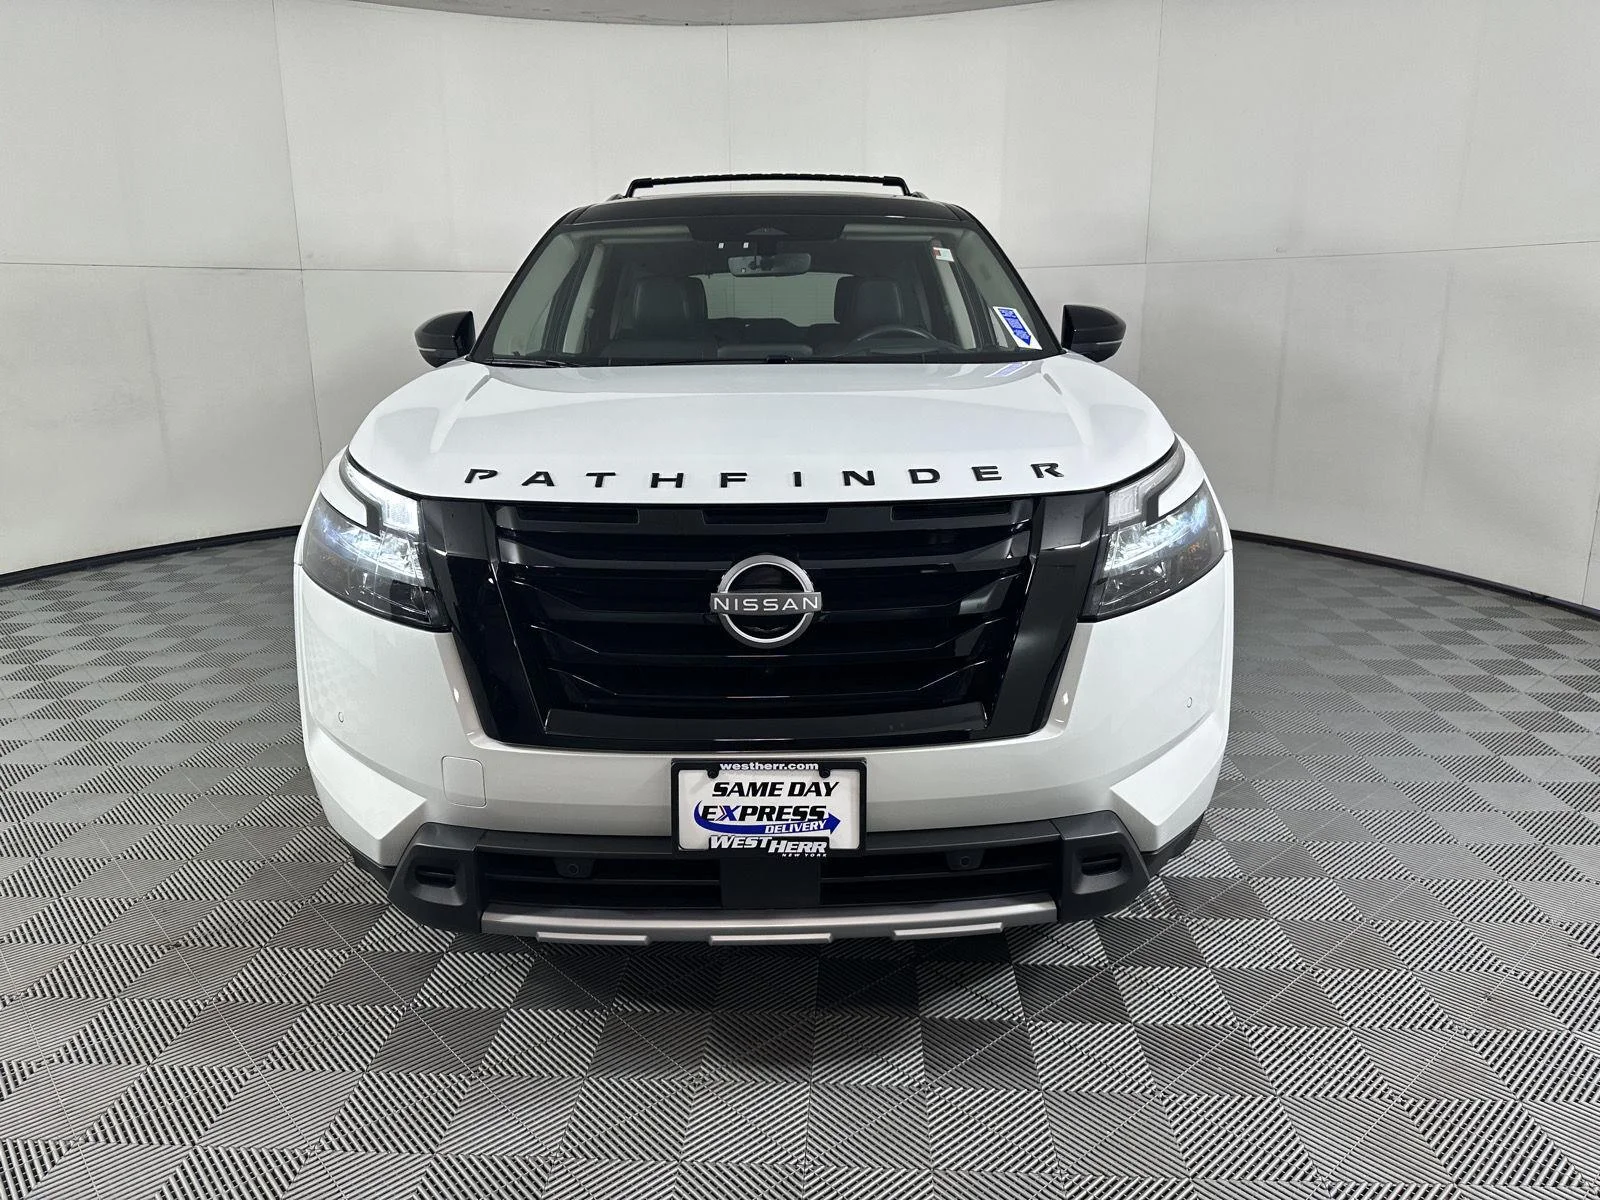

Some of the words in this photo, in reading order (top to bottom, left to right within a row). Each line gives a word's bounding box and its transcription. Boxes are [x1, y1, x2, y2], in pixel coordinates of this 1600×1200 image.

[464, 462, 1064, 490] PATHFINDER
[713, 596, 818, 612] NISSAN
[719, 762, 819, 771] westherr.com
[712, 781, 784, 797] SAME
[788, 781, 840, 797] DAY
[701, 805, 827, 822] EXPRESS
[765, 820, 827, 834] DELIVERY
